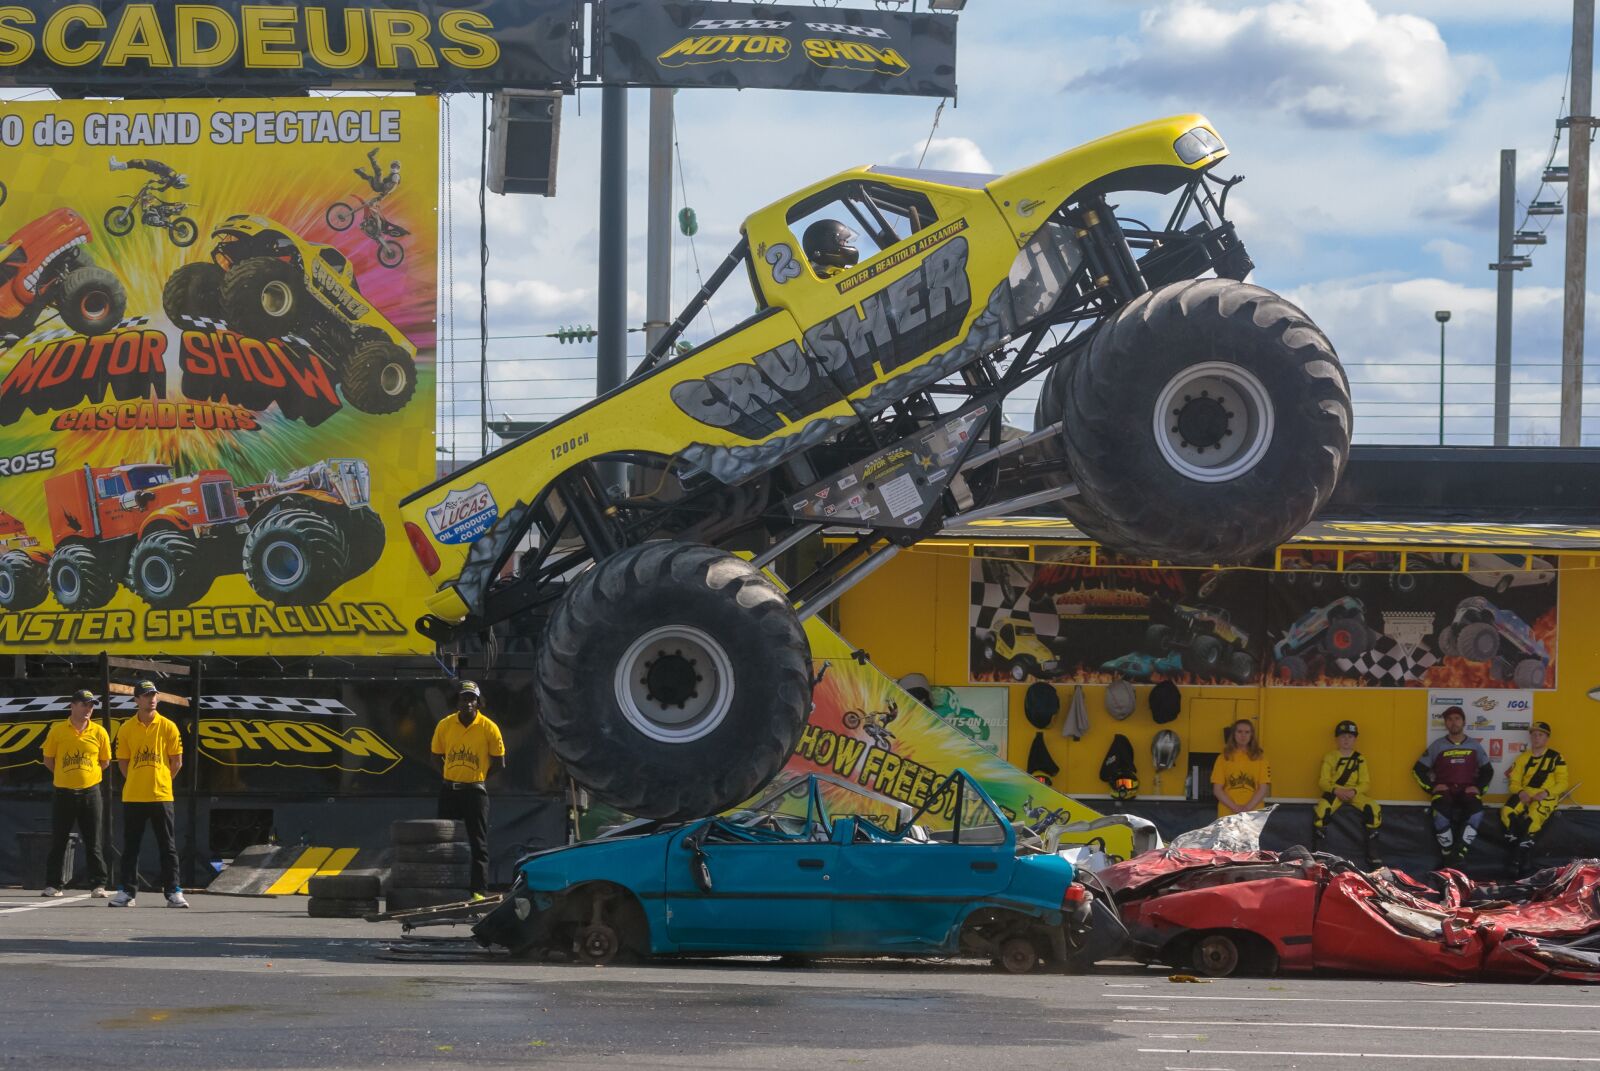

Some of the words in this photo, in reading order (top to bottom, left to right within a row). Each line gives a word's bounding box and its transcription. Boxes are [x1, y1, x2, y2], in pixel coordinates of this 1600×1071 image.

[0, 4, 500, 69] SCADEURS
[659, 35, 788, 61] MOTOR
[806, 39, 909, 69] SHOW
[33, 113, 74, 147] de
[84, 111, 200, 146] GRAND
[210, 109, 401, 145] SPECTACLE
[840, 272, 870, 293] DRIVER
[875, 245, 918, 275] BEAUTOUR
[919, 220, 965, 251] ALEXANDRE
[670, 237, 971, 434] CRUSHER
[1, 329, 167, 398] MOTOR
[183, 329, 342, 408] SHOW
[54, 402, 260, 432] CASCADEURS
[551, 437, 576, 461] 1200
[440, 493, 488, 531] LUCAS
[440, 530, 454, 542] OIL
[453, 508, 498, 535] PRODUCTS
[145, 602, 405, 638] SPECTACULAR
[1507, 700, 1529, 709] IGOL
[201, 721, 398, 761] SHOW
